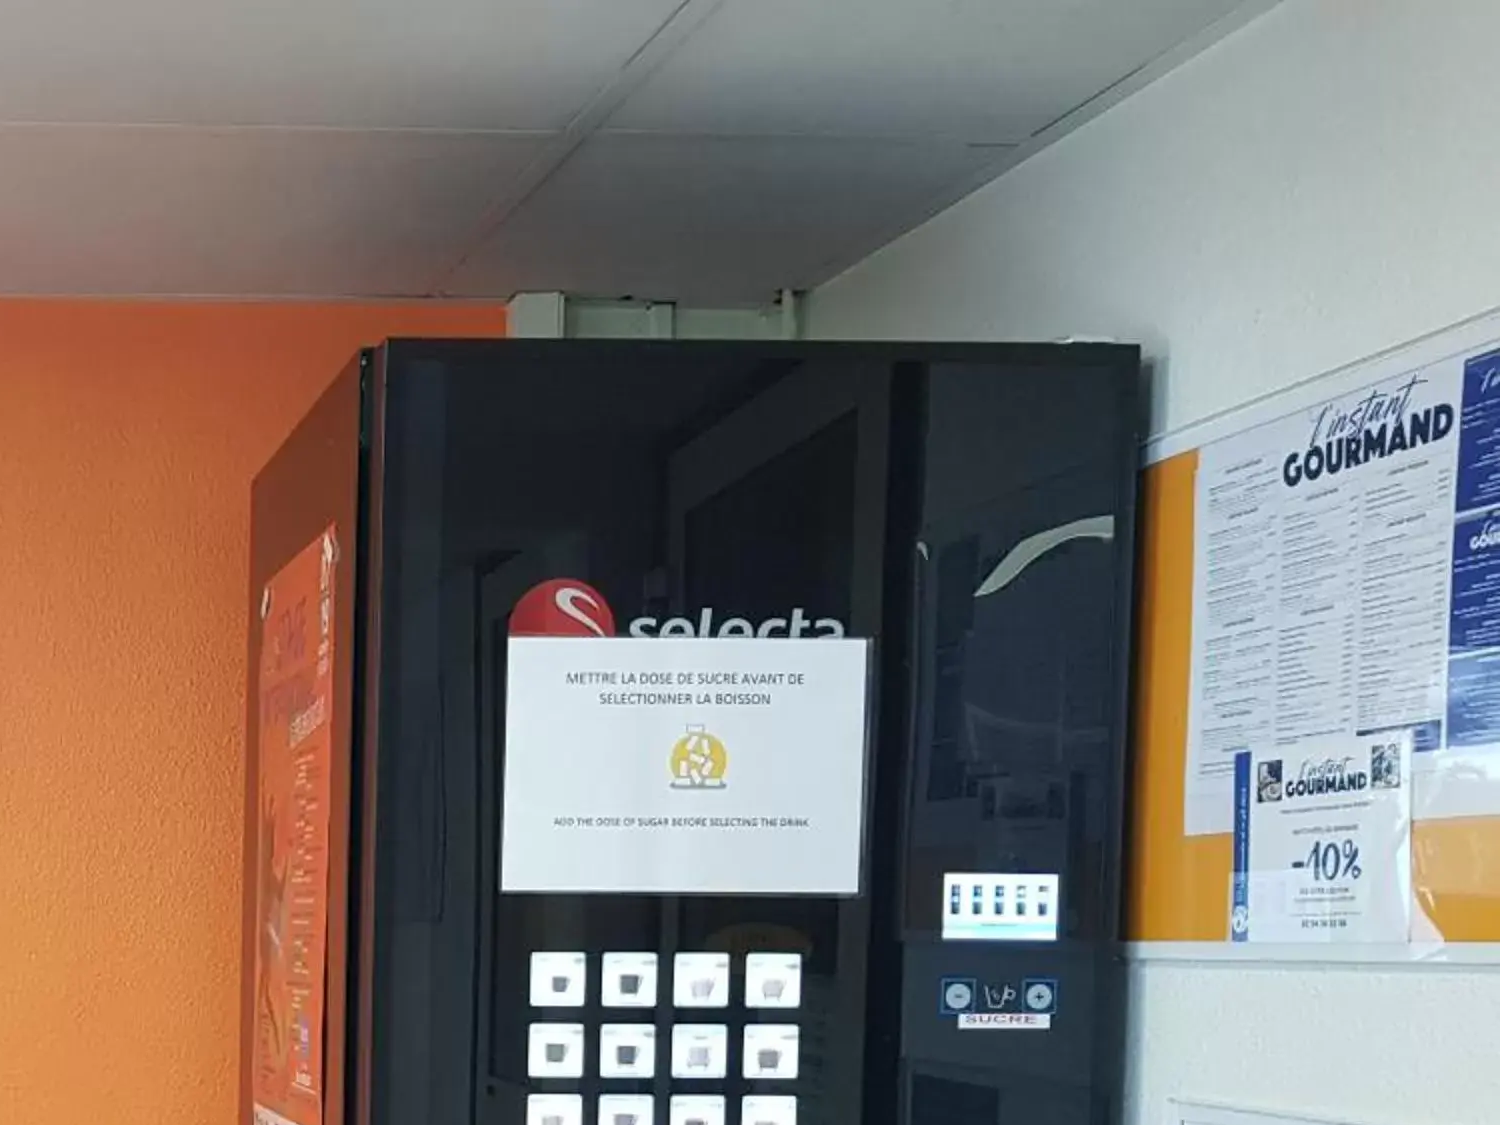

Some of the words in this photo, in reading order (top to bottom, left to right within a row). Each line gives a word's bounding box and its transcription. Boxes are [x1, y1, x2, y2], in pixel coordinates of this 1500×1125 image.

[1283, 403, 1454, 487] GOURMAND
[566, 672, 617, 685] METTRE
[621, 672, 636, 685] LA
[639, 672, 672, 685] DOSE
[676, 672, 694, 685] DE
[697, 672, 738, 685] SUCRE
[741, 673, 784, 685] AVANT
[787, 673, 804, 685] DE
[696, 693, 711, 705] LA
[714, 692, 771, 705] BOISSON
[1285, 771, 1368, 798] GOURMAND
[554, 817, 574, 827] ADD
[577, 817, 593, 827] THE
[596, 817, 620, 827] DOSE
[623, 817, 635, 827] OF
[638, 817, 668, 827] SUGAR
[671, 817, 707, 827] BEFORE
[709, 817, 758, 828] SELECTING
[761, 817, 778, 828] THE
[779, 817, 809, 828] DRINK
[1292, 839, 1363, 882] -10%
[966, 1015, 1036, 1024] SUCRE
